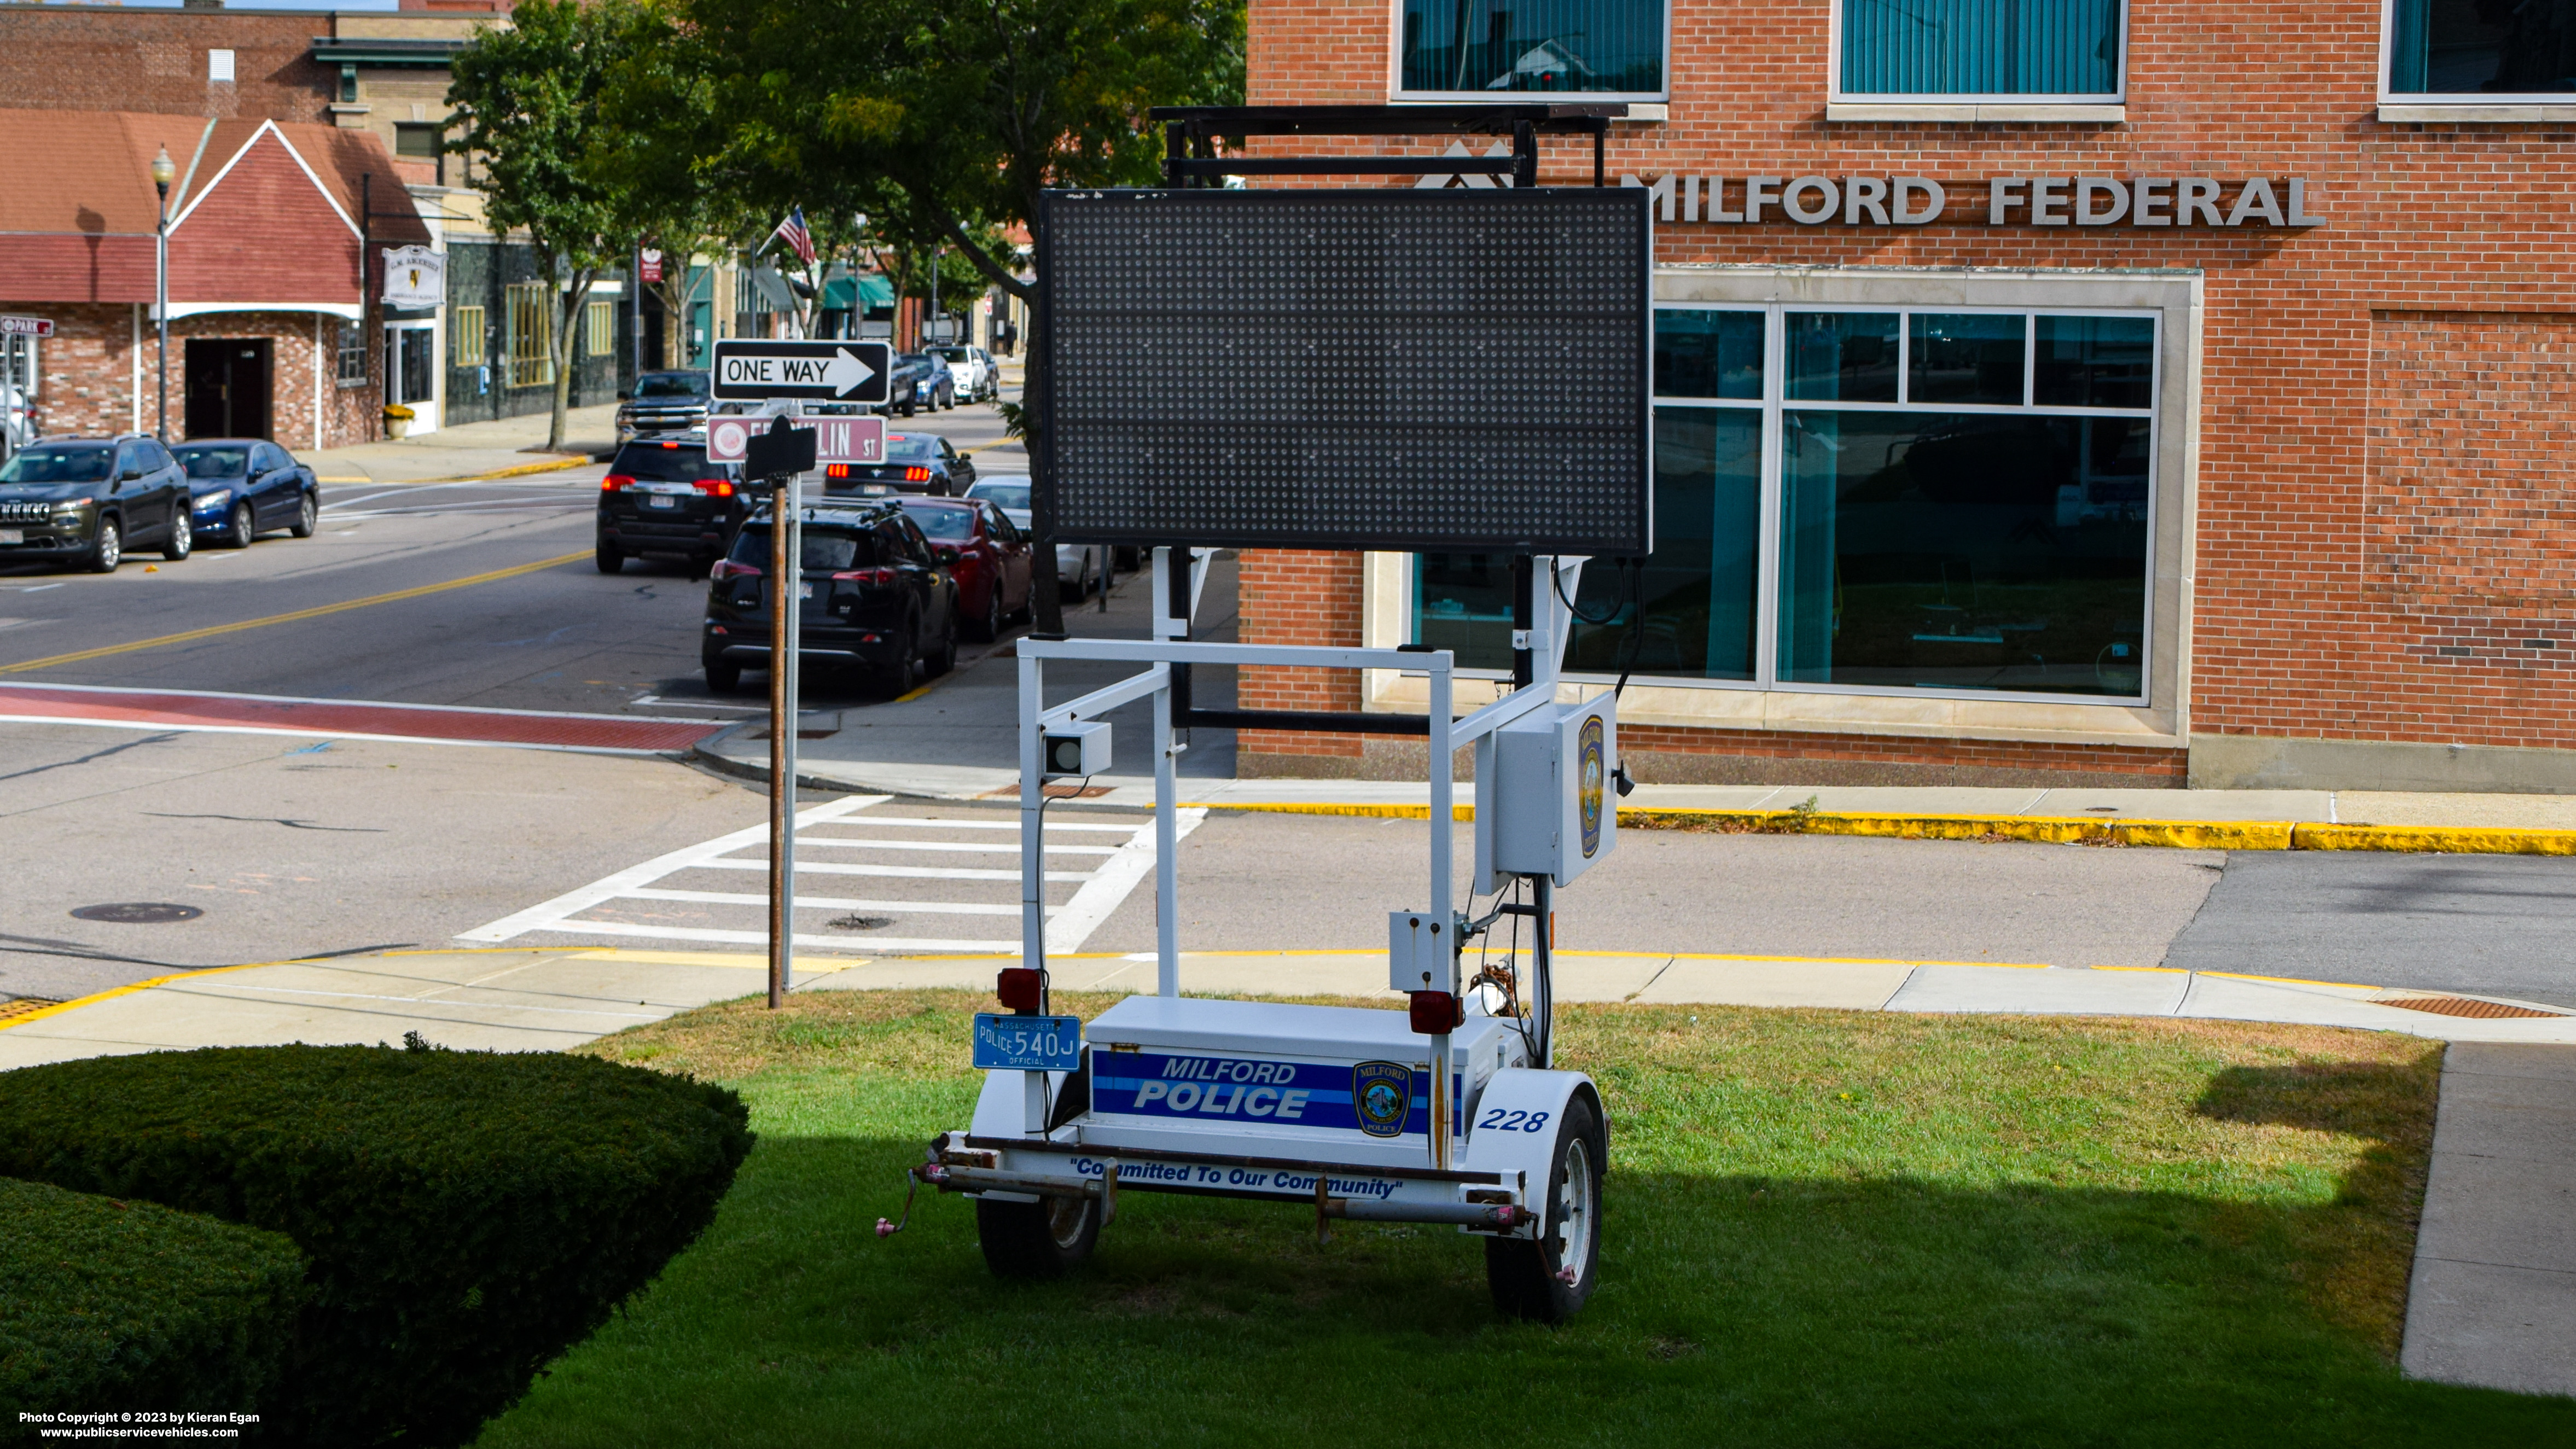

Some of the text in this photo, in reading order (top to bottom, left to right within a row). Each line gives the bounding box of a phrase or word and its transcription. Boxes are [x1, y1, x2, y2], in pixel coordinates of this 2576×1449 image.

[1620, 173, 2327, 228] MILFORD FEDERAL
[14, 319, 38, 333] PARK
[728, 359, 830, 382] ONE WAY
[863, 439, 876, 456] ST
[980, 1026, 1012, 1055] POLICE
[1009, 1057, 1044, 1066] OFFICIAL
[1162, 1058, 1296, 1084] MILFORD
[1360, 1066, 1405, 1080] MILFORD
[1133, 1080, 1310, 1118] POLICE
[1368, 1124, 1396, 1132] POLICE
[1478, 1109, 1549, 1133] 228
[1070, 1158, 1191, 1181] "Comitted
[1197, 1166, 1221, 1183] To
[1229, 1168, 1267, 1186] Our
